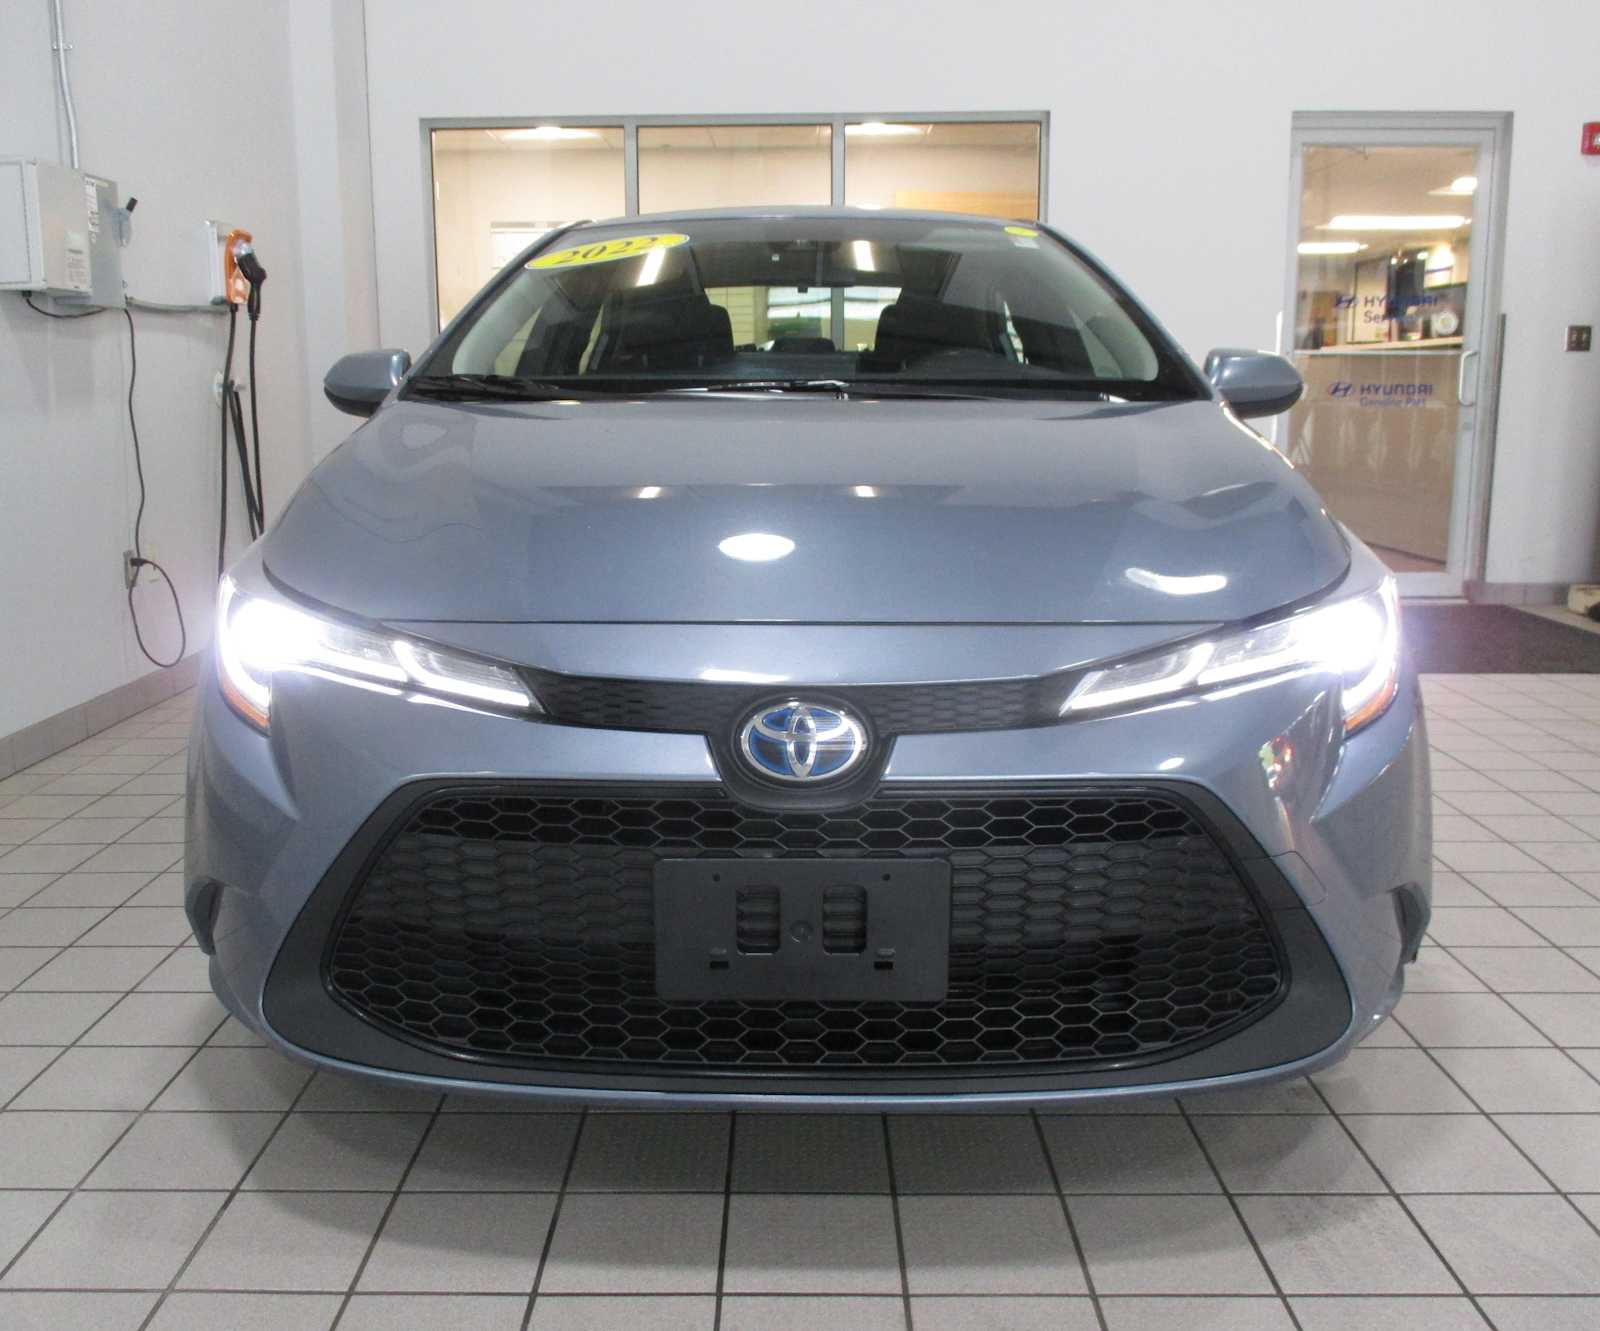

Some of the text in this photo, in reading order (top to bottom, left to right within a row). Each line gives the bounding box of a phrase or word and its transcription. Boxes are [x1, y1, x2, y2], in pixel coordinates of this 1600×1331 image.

[554, 237, 658, 263] 2022
[1364, 295, 1438, 307] HYAI
[1360, 383, 1433, 396] HYUNDAI
